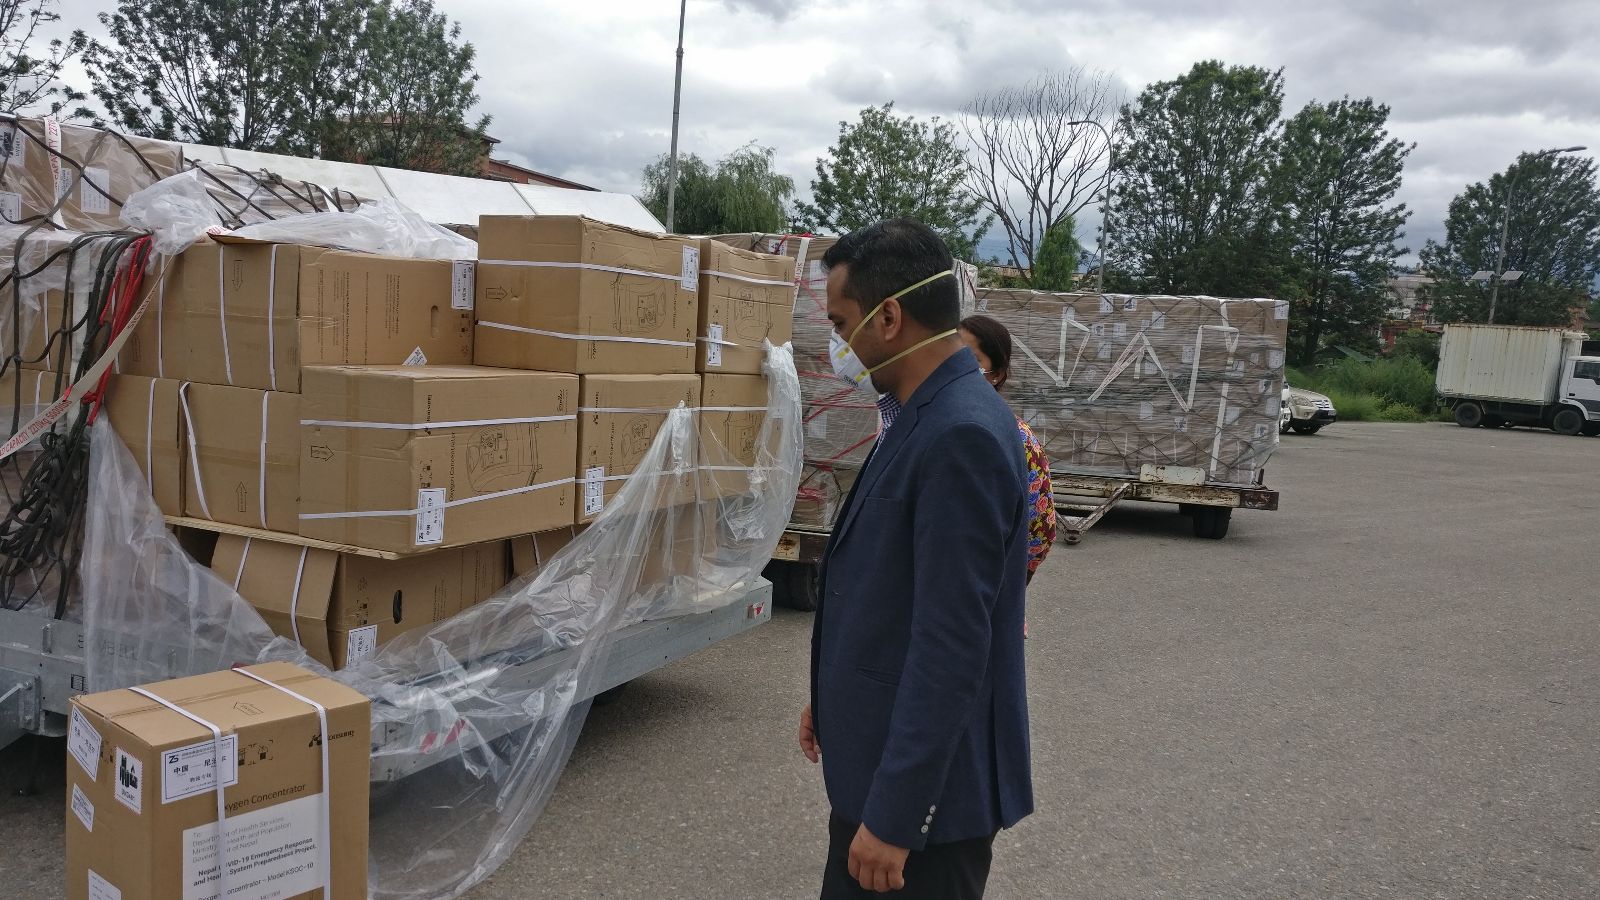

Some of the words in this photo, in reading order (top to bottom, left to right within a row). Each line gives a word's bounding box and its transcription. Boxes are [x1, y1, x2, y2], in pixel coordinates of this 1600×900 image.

[251, 784, 306, 804] Concentrator
[194, 877, 206, 886] and
[207, 872, 222, 882] Heal
[230, 863, 253, 875] System
[254, 851, 294, 867] Preparedness
[199, 865, 217, 876] Nepal
[251, 846, 283, 860] Emergency
[285, 838, 313, 850] Response
[227, 879, 261, 895] oncentrator
